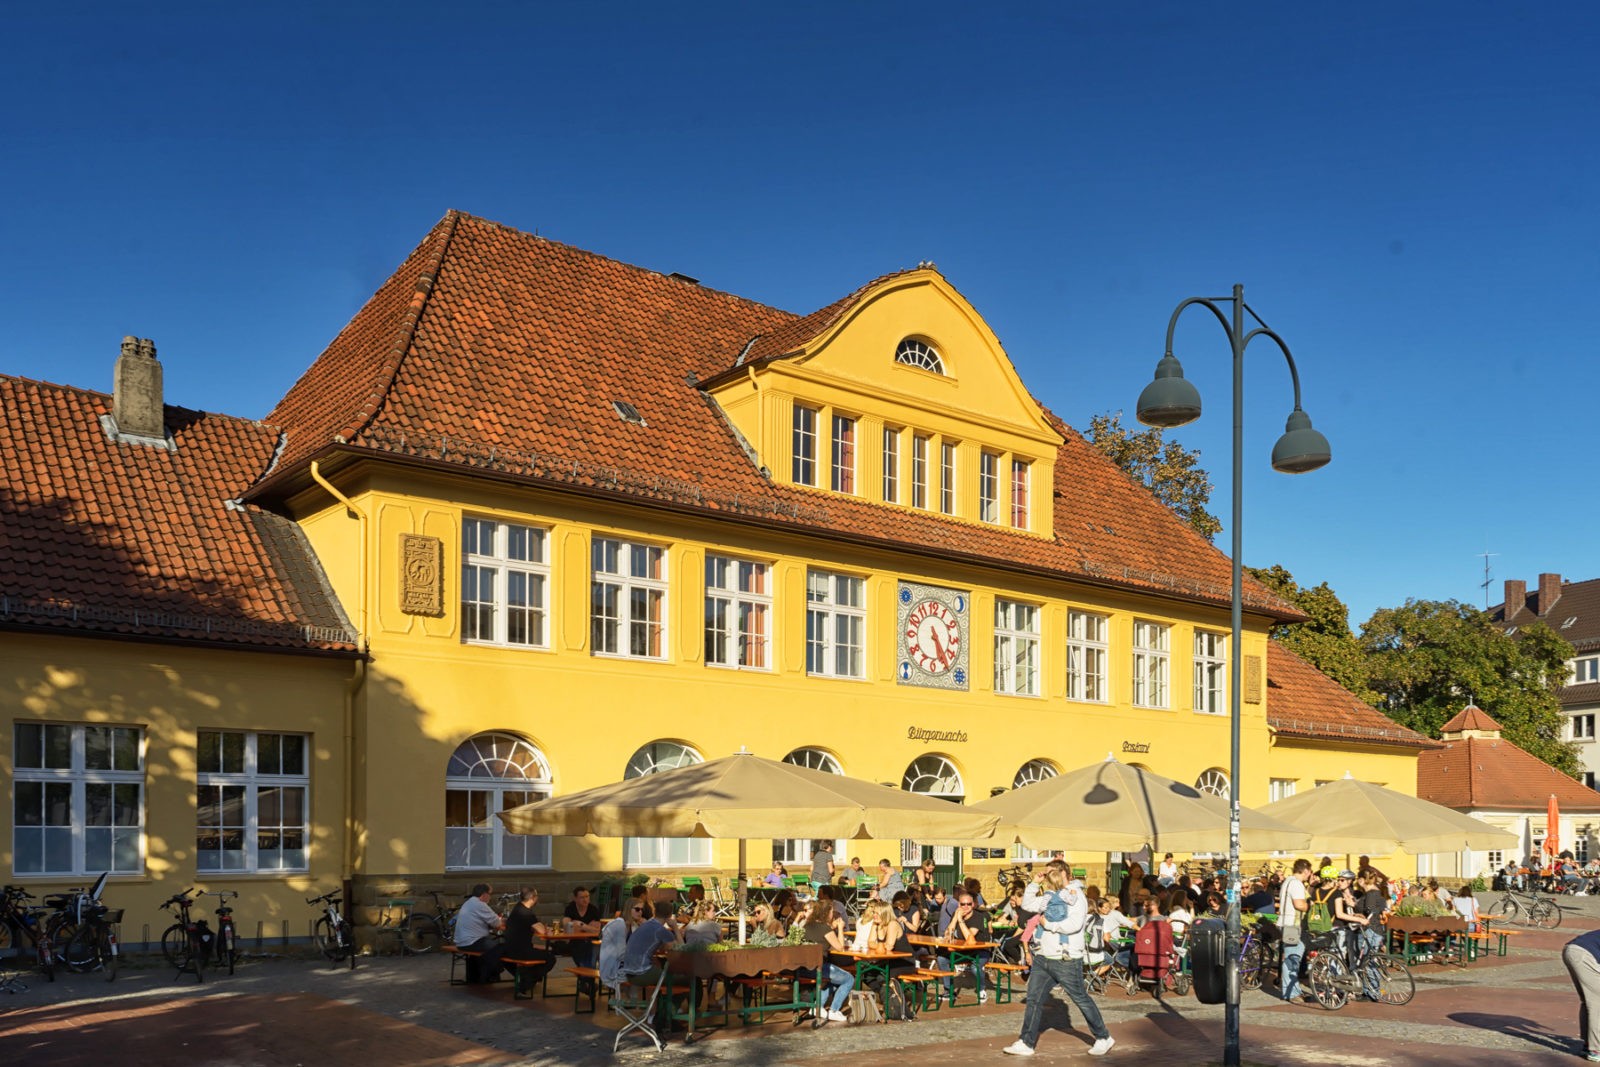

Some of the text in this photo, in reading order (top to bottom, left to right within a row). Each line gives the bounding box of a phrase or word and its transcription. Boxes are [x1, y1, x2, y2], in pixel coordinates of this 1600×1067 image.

[918, 603, 928, 619] 11
[929, 602, 938, 615] 12
[941, 608, 948, 619] 1
[909, 613, 920, 628] 10
[946, 620, 957, 631] 2
[907, 629, 917, 638] 9
[949, 635, 959, 646] 3
[909, 643, 919, 656] 8
[946, 648, 956, 660] 4
[919, 652, 929, 666] 7
[929, 658, 937, 672] 6
[907, 725, 969, 744] Bürgerwache
